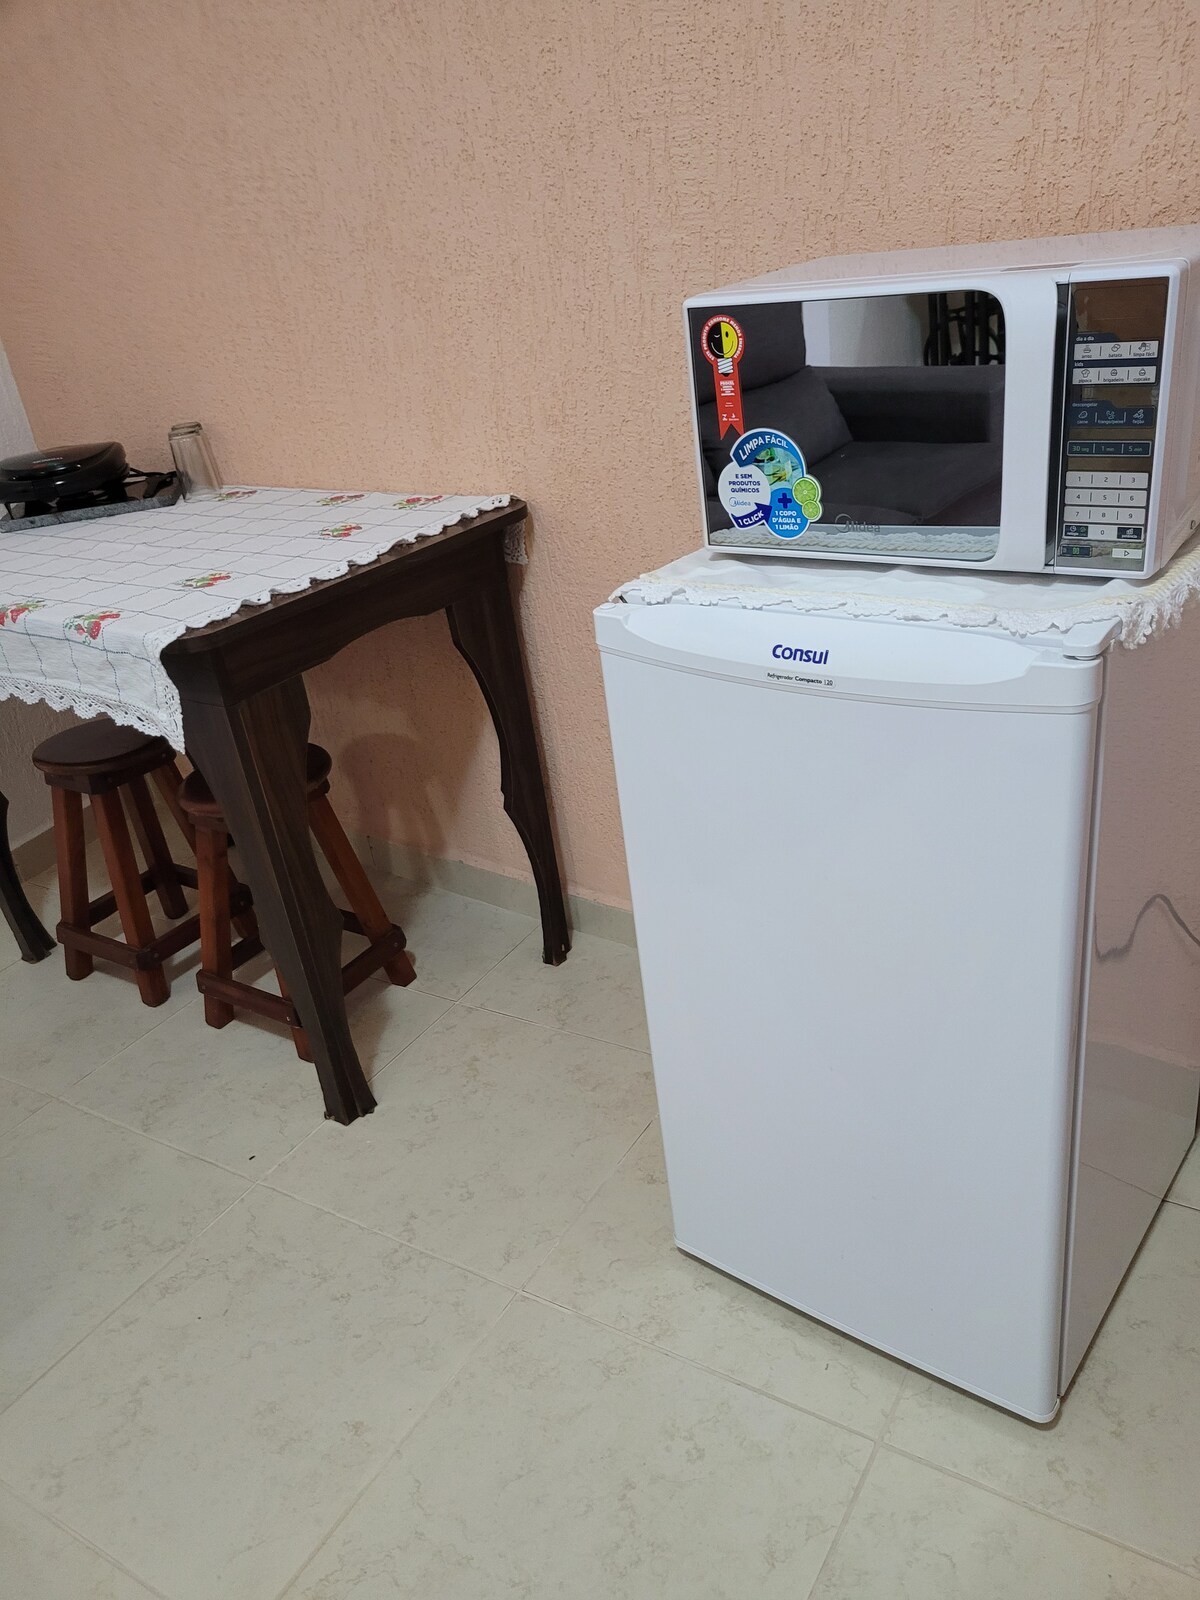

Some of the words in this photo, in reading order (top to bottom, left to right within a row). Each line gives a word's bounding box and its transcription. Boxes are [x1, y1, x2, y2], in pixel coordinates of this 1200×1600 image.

[739, 436, 764, 461] LIMPA
[765, 434, 788, 449] FÁCIL
[729, 499, 751, 507] Midea
[743, 510, 764, 525] CLICK
[838, 517, 880, 533] Midea
[772, 644, 829, 665] Consul
[767, 672, 793, 680] Refrigerador
[794, 676, 822, 684] Compacto
